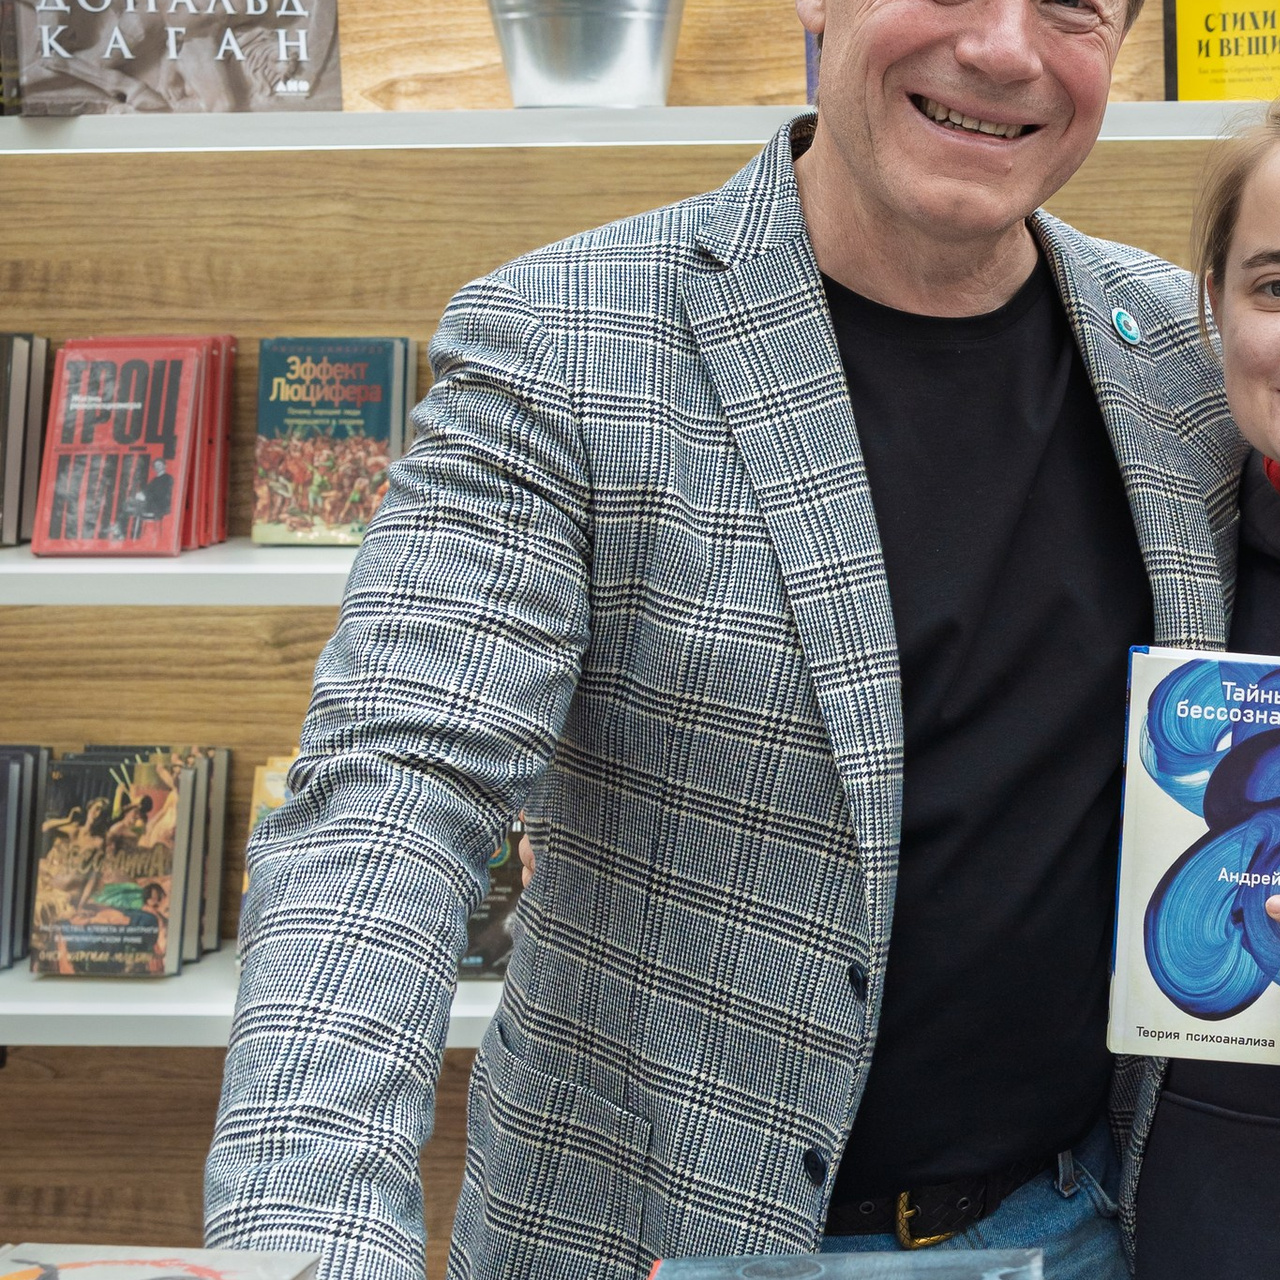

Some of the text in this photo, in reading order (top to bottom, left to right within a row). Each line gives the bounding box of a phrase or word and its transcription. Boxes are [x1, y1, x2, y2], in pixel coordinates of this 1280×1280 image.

[1204, 10, 1277, 33] СТИХИ
[39, 25, 311, 62] КАГАН
[1197, 38, 1211, 58] И
[285, 355, 369, 385] Эффект
[269, 376, 383, 408] Люцифера
[66, 358, 184, 460] ТРОЦ
[1135, 1024, 1276, 1049] Теория психоанализа
